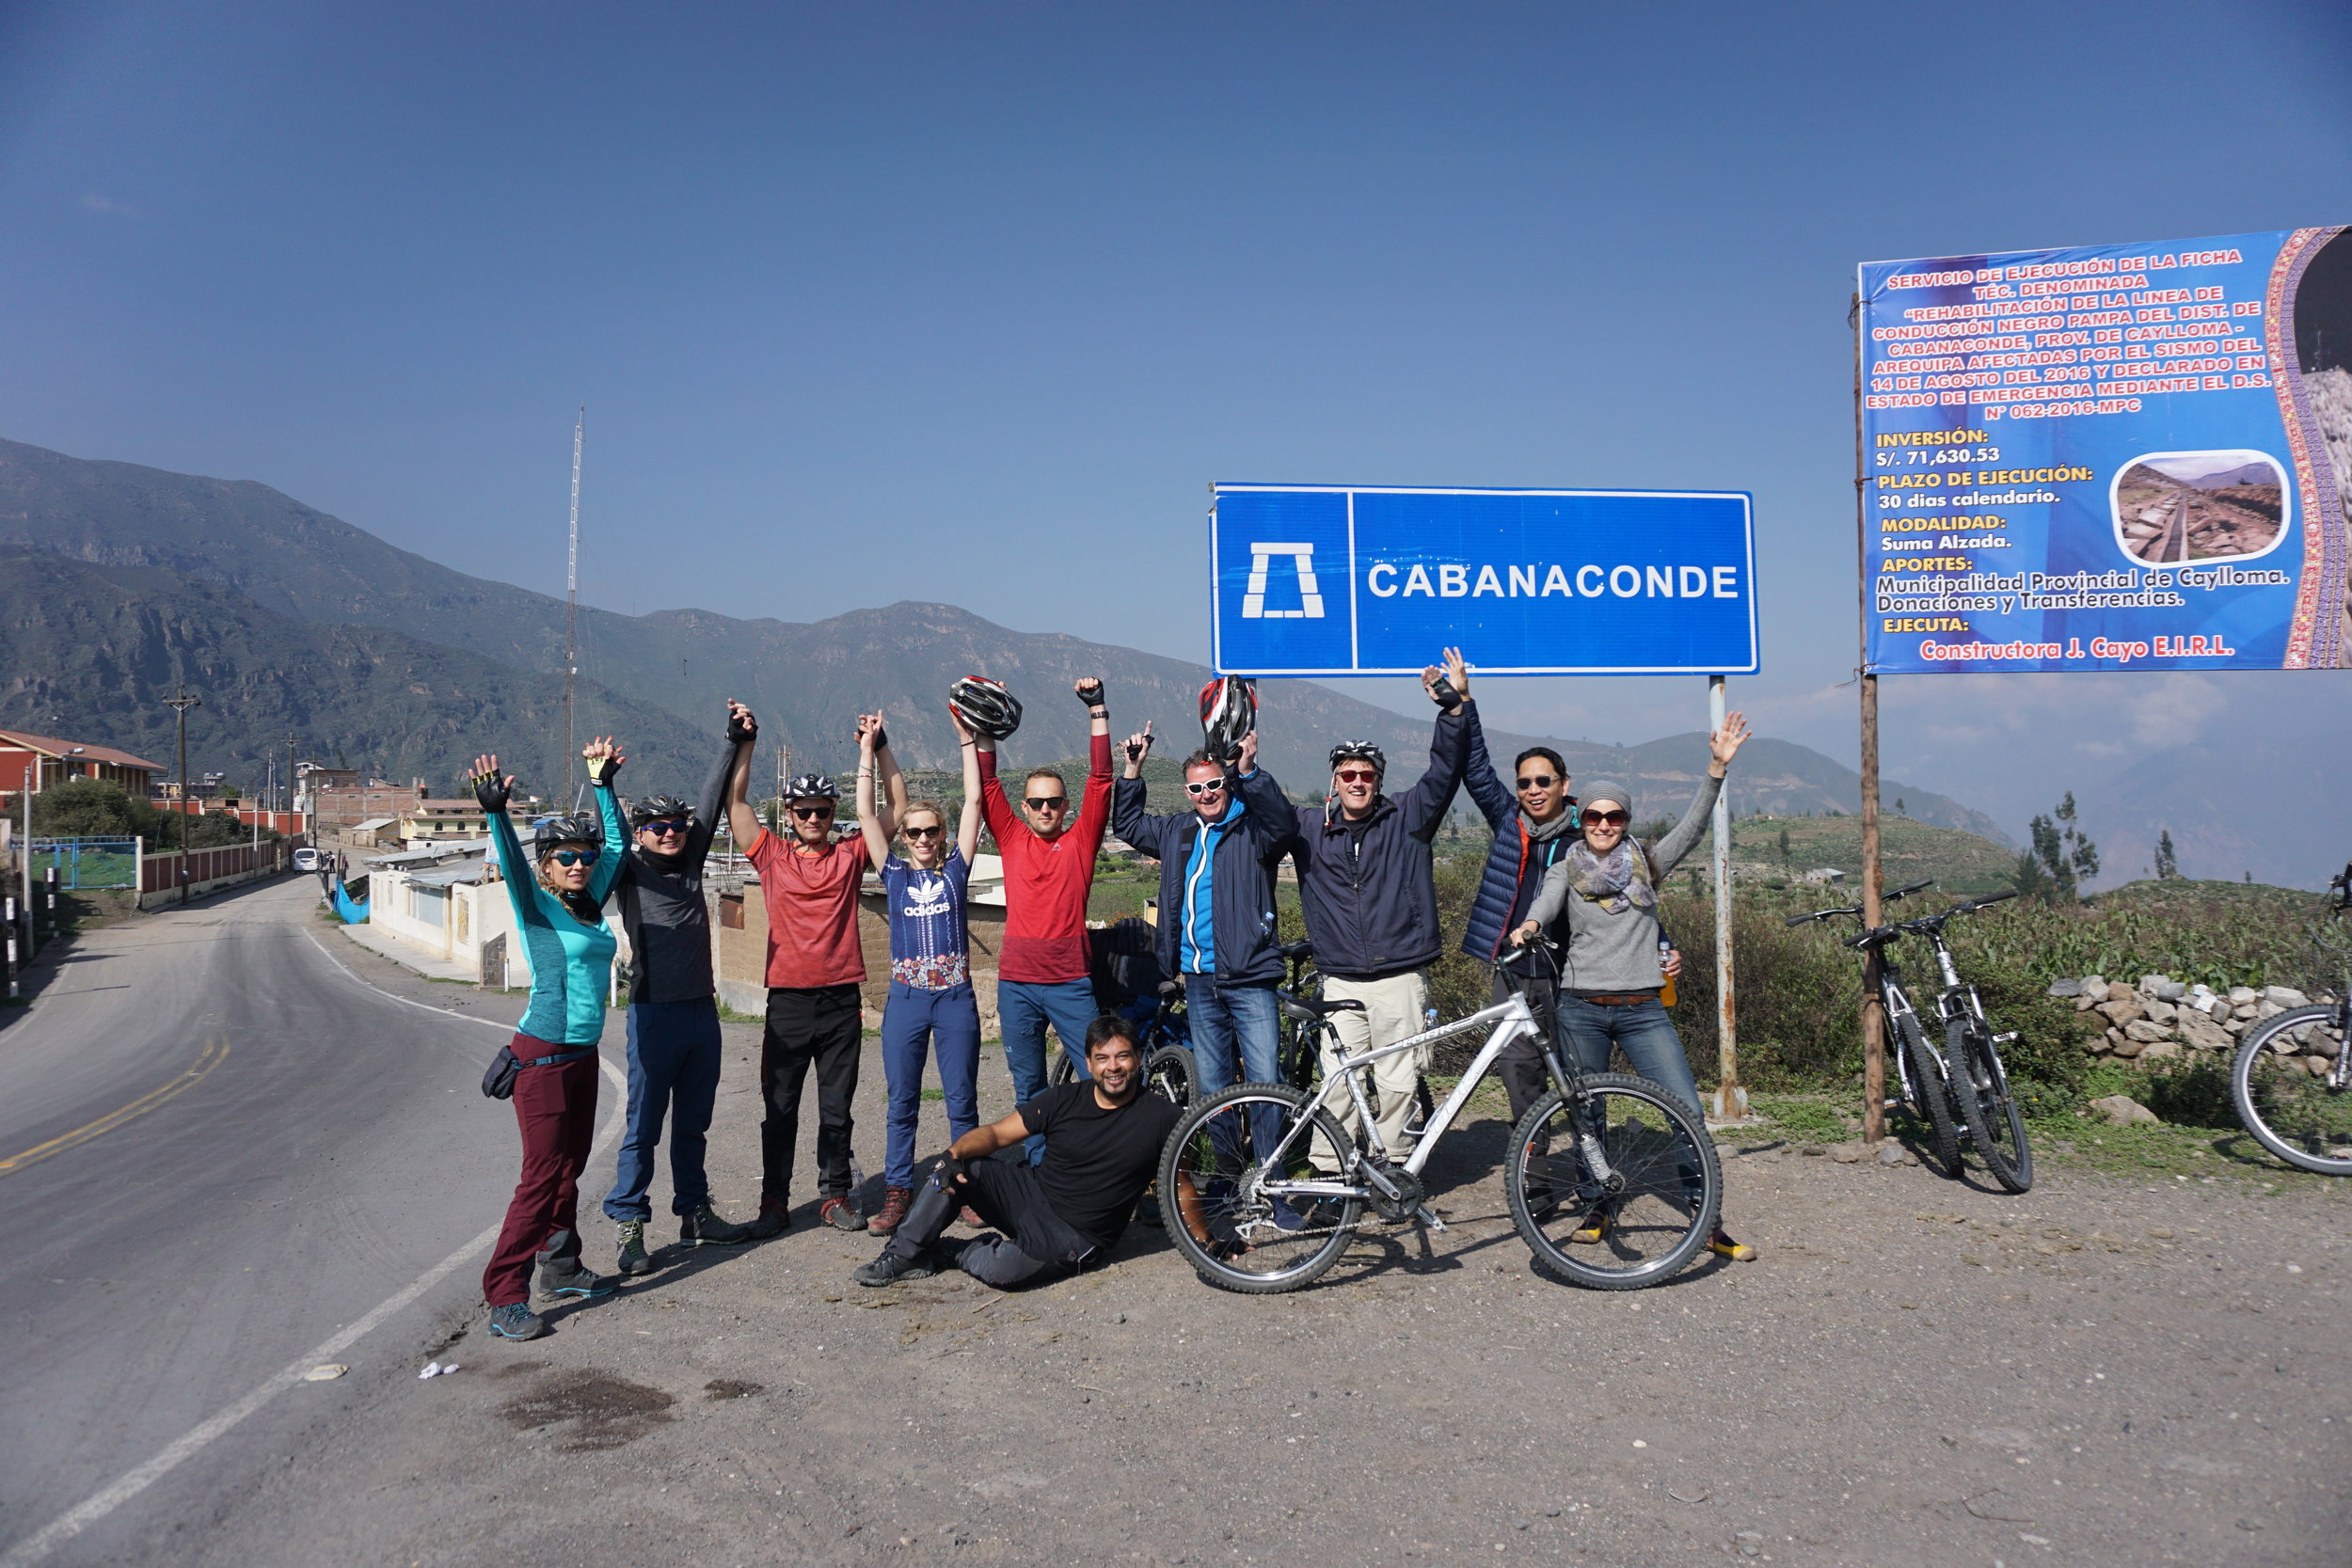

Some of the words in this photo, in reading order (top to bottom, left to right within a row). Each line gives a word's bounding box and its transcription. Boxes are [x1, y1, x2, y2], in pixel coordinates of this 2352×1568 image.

[1888, 271, 1973, 289] SERVICIO
[1979, 269, 2002, 282] DE
[2007, 258, 2114, 279] EJECUCIÓN
[2121, 259, 2146, 271] DE
[2151, 255, 2177, 269] LA
[2182, 249, 2242, 266] FICHA
[1975, 284, 2015, 299] TÉC.
[2021, 275, 2149, 296] DENOMINADA
[2074, 296, 2098, 310] DE
[2103, 293, 2129, 308] LA
[2133, 290, 2192, 305] LINEA
[2196, 286, 2223, 301] DE
[1873, 320, 1992, 341] CONDUCCIÓN
[1998, 316, 2063, 332] NEGRO
[2068, 311, 2133, 328] PAMPA
[2137, 309, 2175, 323] DEL
[2180, 305, 2229, 320] DIST.
[2233, 302, 2261, 316] DE
[1889, 337, 2031, 356] CABANACONDE,
[2036, 331, 2090, 347] PROV.
[2096, 329, 2121, 343] DE
[2126, 323, 2232, 341] CAYLLOMA
[1873, 357, 1964, 374] AREQUIPA
[1969, 350, 2076, 370] AFECTADAS
[2082, 347, 2122, 361] POR
[2125, 345, 2151, 358] EL
[2155, 341, 2217, 356] SISMO
[2223, 339, 2262, 353] DEL
[1871, 378, 1892, 391] 14
[1897, 377, 1921, 389] DE
[1926, 372, 2000, 388] AGOSTO
[2005, 371, 2042, 384] DEL
[2045, 366, 2090, 381] 2016
[2095, 365, 2109, 378] Y
[2114, 357, 2232, 377] DECLARADO
[2236, 356, 2265, 370] EN
[1867, 393, 1936, 408] ESTADO
[1941, 391, 1966, 404] DE
[1970, 385, 2093, 403] EMERGENCIA
[2097, 377, 2199, 396] MEDIANTE
[2203, 375, 2229, 389] EL
[2233, 374, 2271, 388] D.S.
[2010, 399, 2141, 418] 062-2016-MPC
[1876, 427, 1989, 448] INVERSIÓN:
[1876, 452, 1901, 467] S/.
[1907, 448, 2000, 466] 71,630.53
[1879, 473, 1942, 489] PLAZO
[1947, 471, 1973, 486] DE
[1978, 464, 2093, 485] EJECUCIÓN:
[1879, 495, 1901, 509] 30
[1907, 493, 1947, 508] dias
[1952, 489, 2060, 507] calendario.
[1881, 515, 2007, 532] MODALIDAD:
[1882, 537, 1933, 551] Suma
[1938, 533, 2012, 550] Alzada.
[1881, 556, 1973, 573] APORTES:
[1368, 563, 1738, 598] CABANACONDE
[1877, 572, 2024, 595] Municipalidad
[2030, 568, 2137, 591] Provincial
[2144, 568, 2172, 586] de
[2178, 566, 2290, 590] Caylloma.
[1877, 594, 1996, 611] Donaciones
[2001, 596, 2015, 613] y
[2020, 590, 2185, 609] Transferencias.
[1883, 617, 1970, 633] EJECUTA:
[1921, 641, 2061, 659] Constructora
[2066, 638, 2086, 657] J.
[2090, 637, 2149, 662] Cayo
[2153, 636, 2235, 657] E.I.R.L.
[904, 902, 950, 916] adidas
